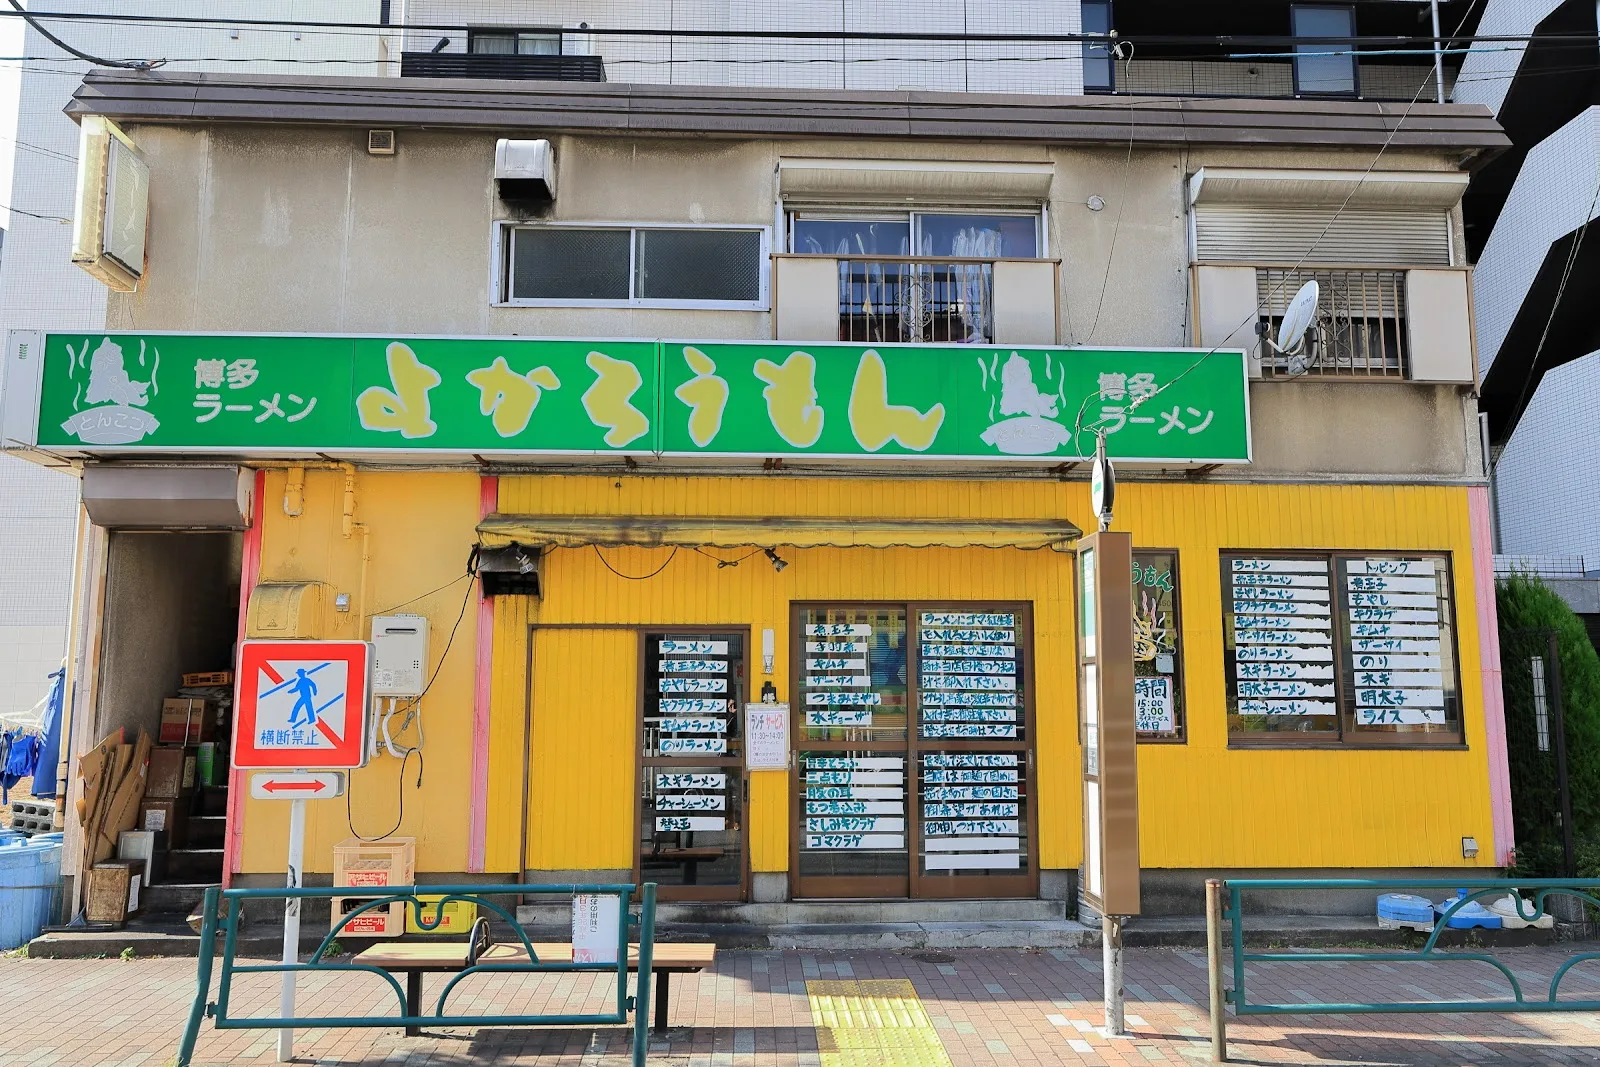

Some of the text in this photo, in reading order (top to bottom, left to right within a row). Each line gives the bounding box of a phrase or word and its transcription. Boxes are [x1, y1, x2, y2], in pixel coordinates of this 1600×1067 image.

[194, 358, 258, 389] 博多
[1098, 371, 1158, 401] 博多
[193, 393, 317, 424] ラーメン
[1099, 406, 1214, 435] ラーメン
[1233, 560, 1270, 571] ラーメン
[1365, 562, 1411, 573] トッピング
[1235, 574, 1292, 585] 煮玉子ラーメン
[1351, 577, 1388, 591] 煮玉子
[1235, 588, 1294, 600] もやしラーメン
[1352, 594, 1389, 605] もやし
[1234, 602, 1298, 613] キクラゲラーメン
[1354, 608, 1397, 620] キクラゲ
[1236, 616, 1290, 627] キムチラーメン
[813, 624, 855, 636] 煮玉子
[1356, 624, 1390, 635] キムチ
[1237, 631, 1296, 643] ザーサイラーメン
[662, 641, 713, 653] ラーメン
[1359, 639, 1402, 650] ザーサイ
[1238, 648, 1293, 660] のりラーメン
[661, 660, 726, 673] 煮玉子ラーメン
[813, 659, 849, 669] キムチ
[1360, 656, 1388, 668] のり
[1241, 663, 1297, 677] ネギラーメン
[660, 679, 724, 692] もやしラーメン
[813, 676, 854, 685] ザーサイ
[1361, 673, 1392, 685] ネギ
[1238, 681, 1306, 696] 明太子ラーメン
[1361, 690, 1408, 705] 明太子
[1241, 700, 1307, 715] チャーシューメン
[751, 713, 784, 730] ランチ サービス
[810, 712, 869, 725] 水ギョーザ
[1363, 710, 1403, 724] ライス
[661, 719, 726, 732] キムチラーメン
[260, 729, 319, 745] 横断禁止
[660, 739, 723, 752] のりラーメン
[658, 774, 721, 788] ネギラーメン
[657, 796, 720, 810] チャーシューメン
[660, 818, 691, 832] 替え玉
[809, 815, 880, 832] さしみキクラゲ
[811, 834, 865, 847] ゴマクラゲ
[348, 873, 387, 881] アサヒビール
